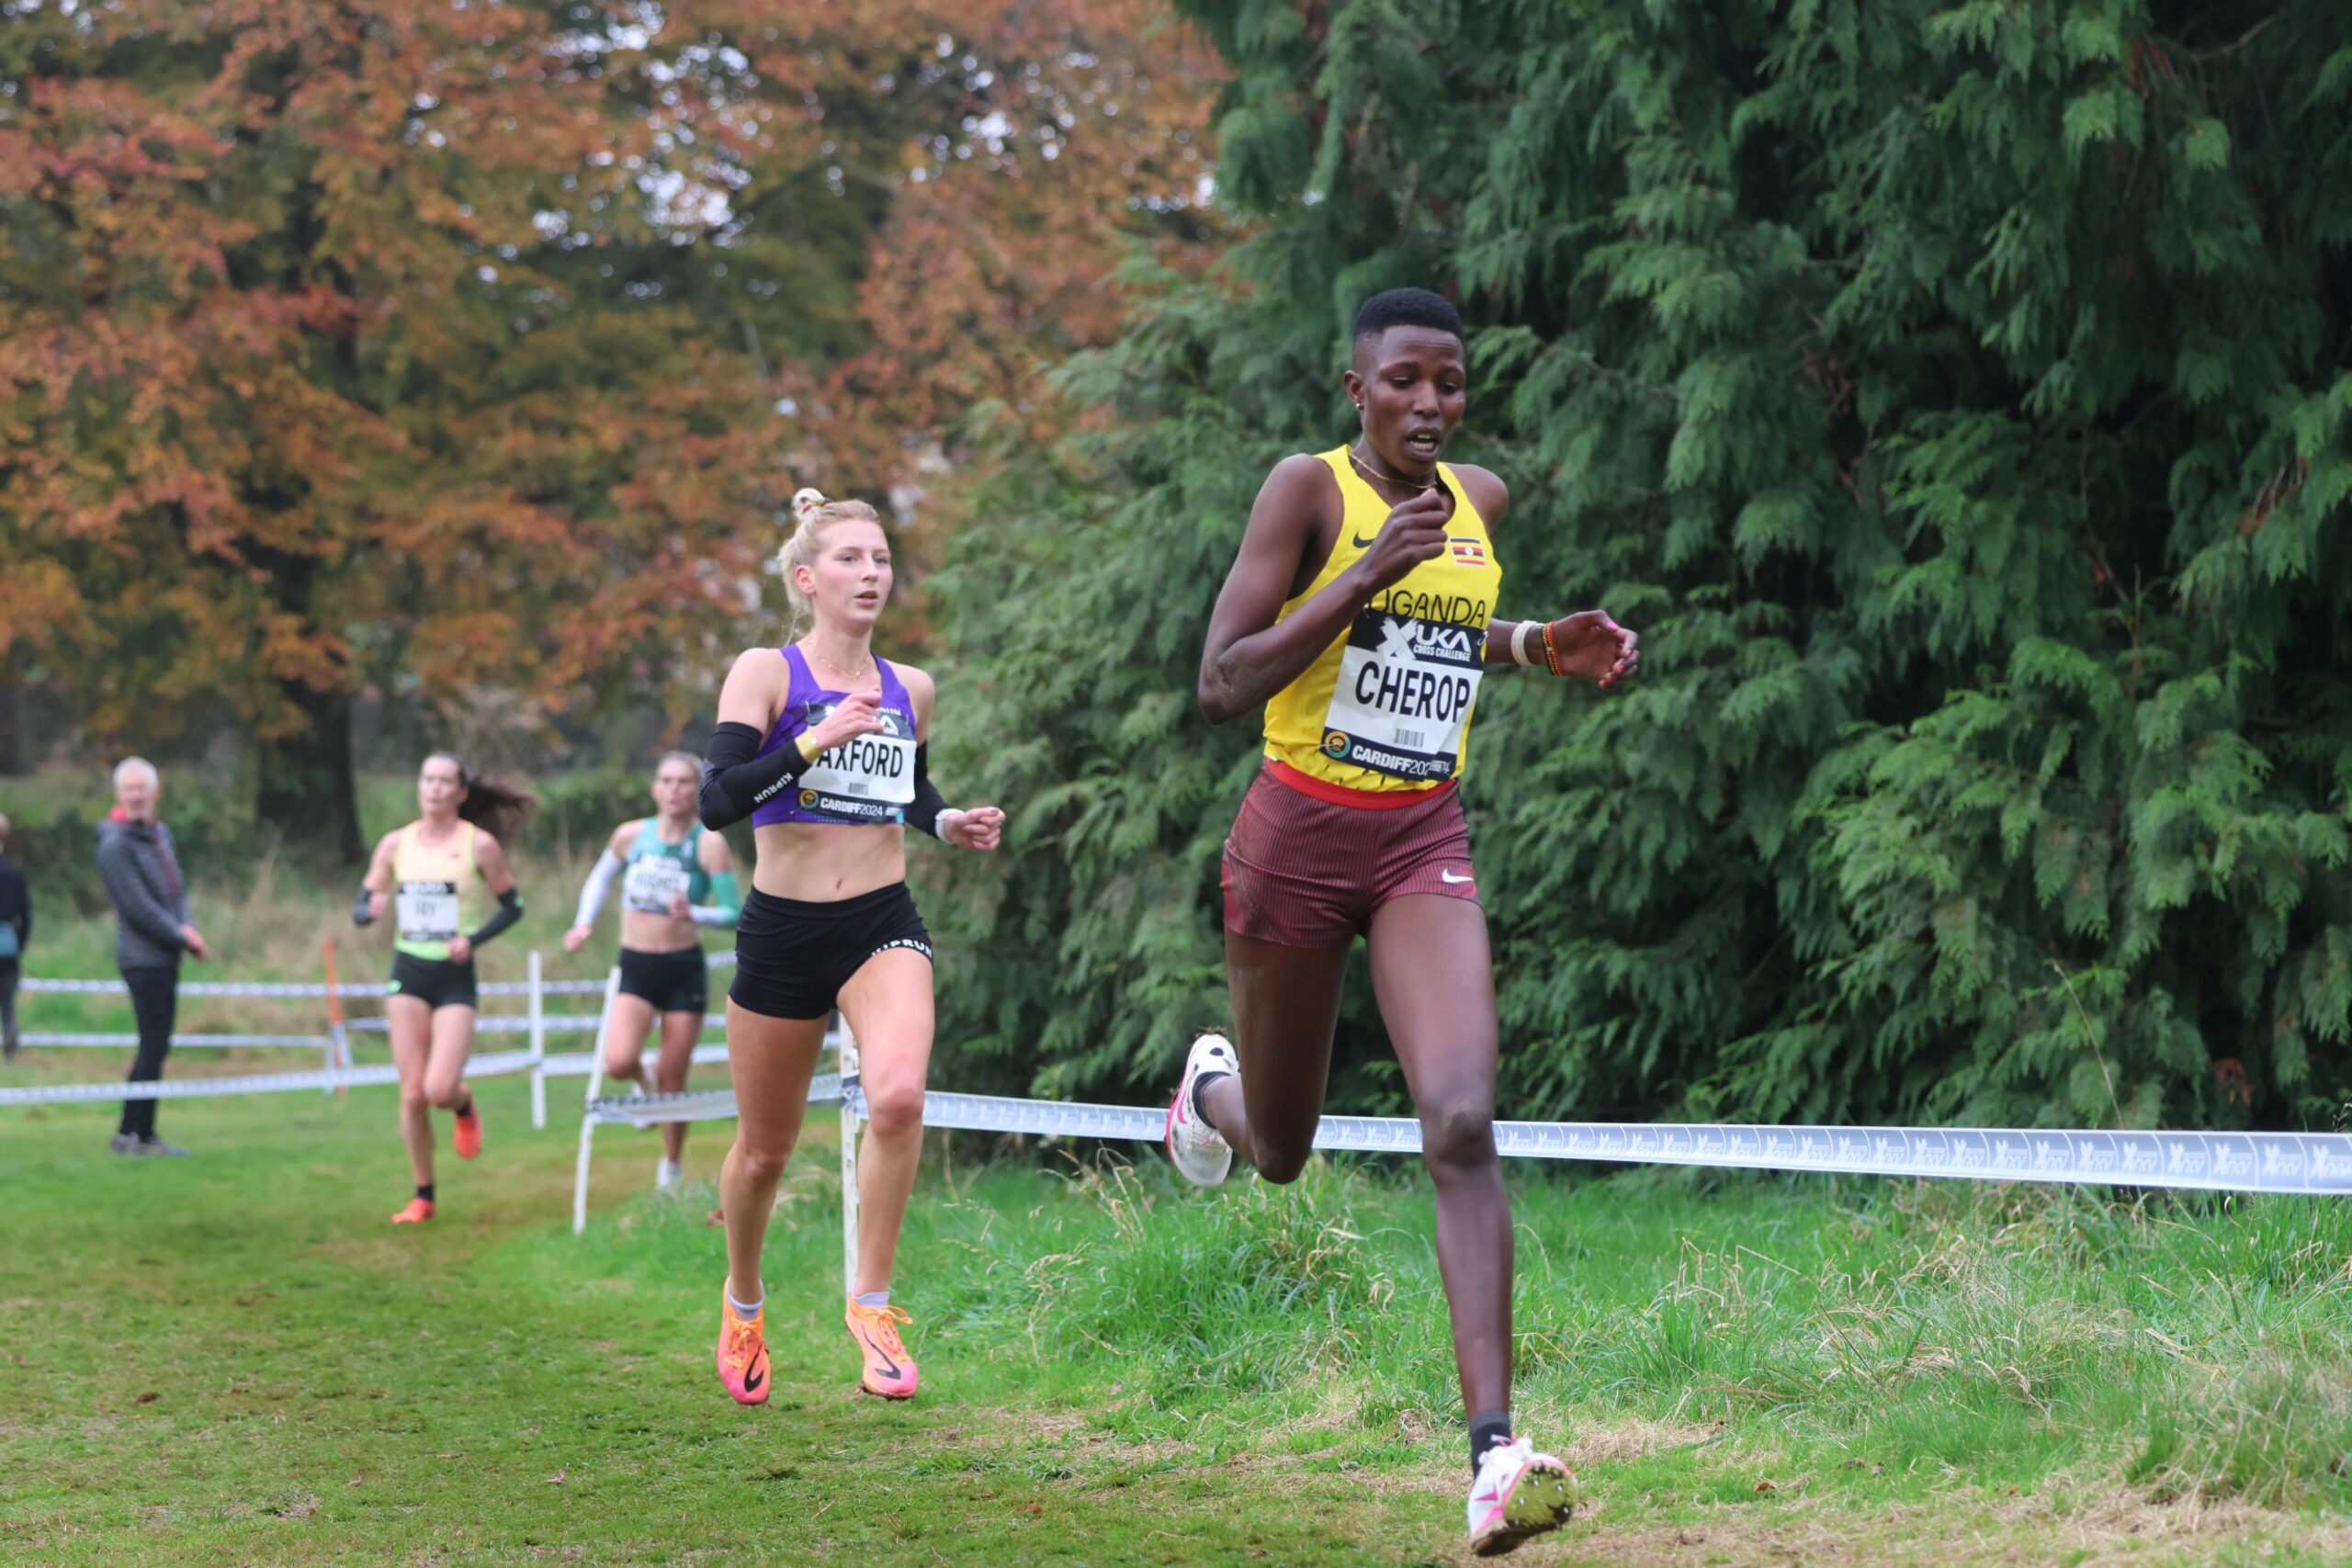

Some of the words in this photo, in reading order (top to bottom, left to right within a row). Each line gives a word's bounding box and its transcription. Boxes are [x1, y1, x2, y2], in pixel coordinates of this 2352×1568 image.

[1413, 645, 1435, 658] CROSS
[1435, 647, 1471, 662] CHALLENGE
[1355, 660, 1471, 723] CHEROP
[753, 772, 794, 804] KIPRUN
